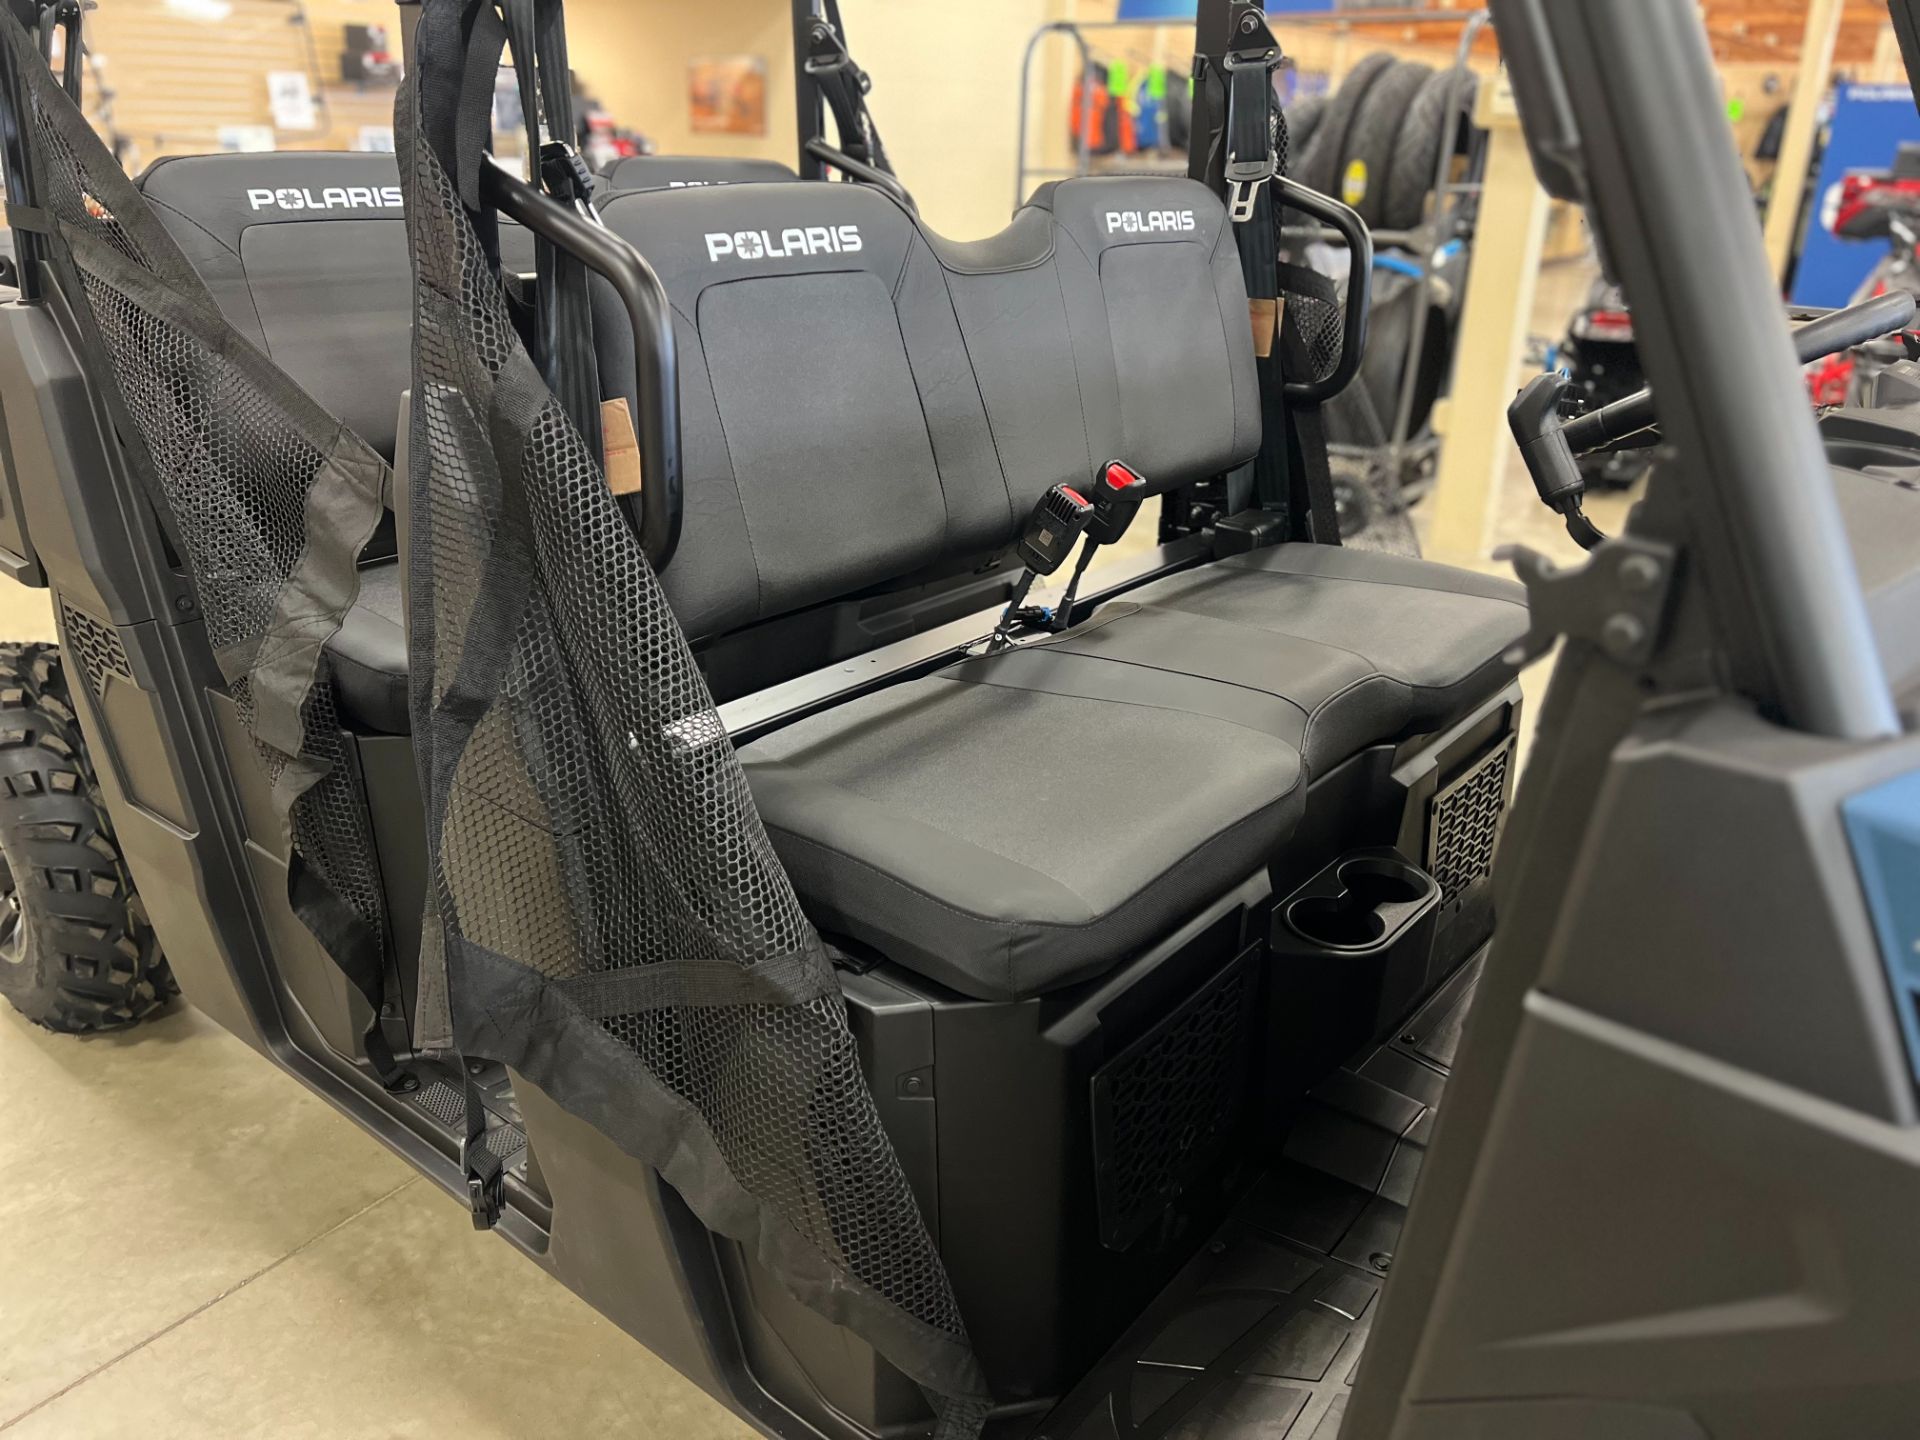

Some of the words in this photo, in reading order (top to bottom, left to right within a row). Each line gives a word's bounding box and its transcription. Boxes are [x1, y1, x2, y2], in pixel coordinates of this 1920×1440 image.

[247, 187, 404, 210] POLARIS
[1105, 210, 1195, 233] POLARIS
[704, 225, 863, 262] POLARIS
